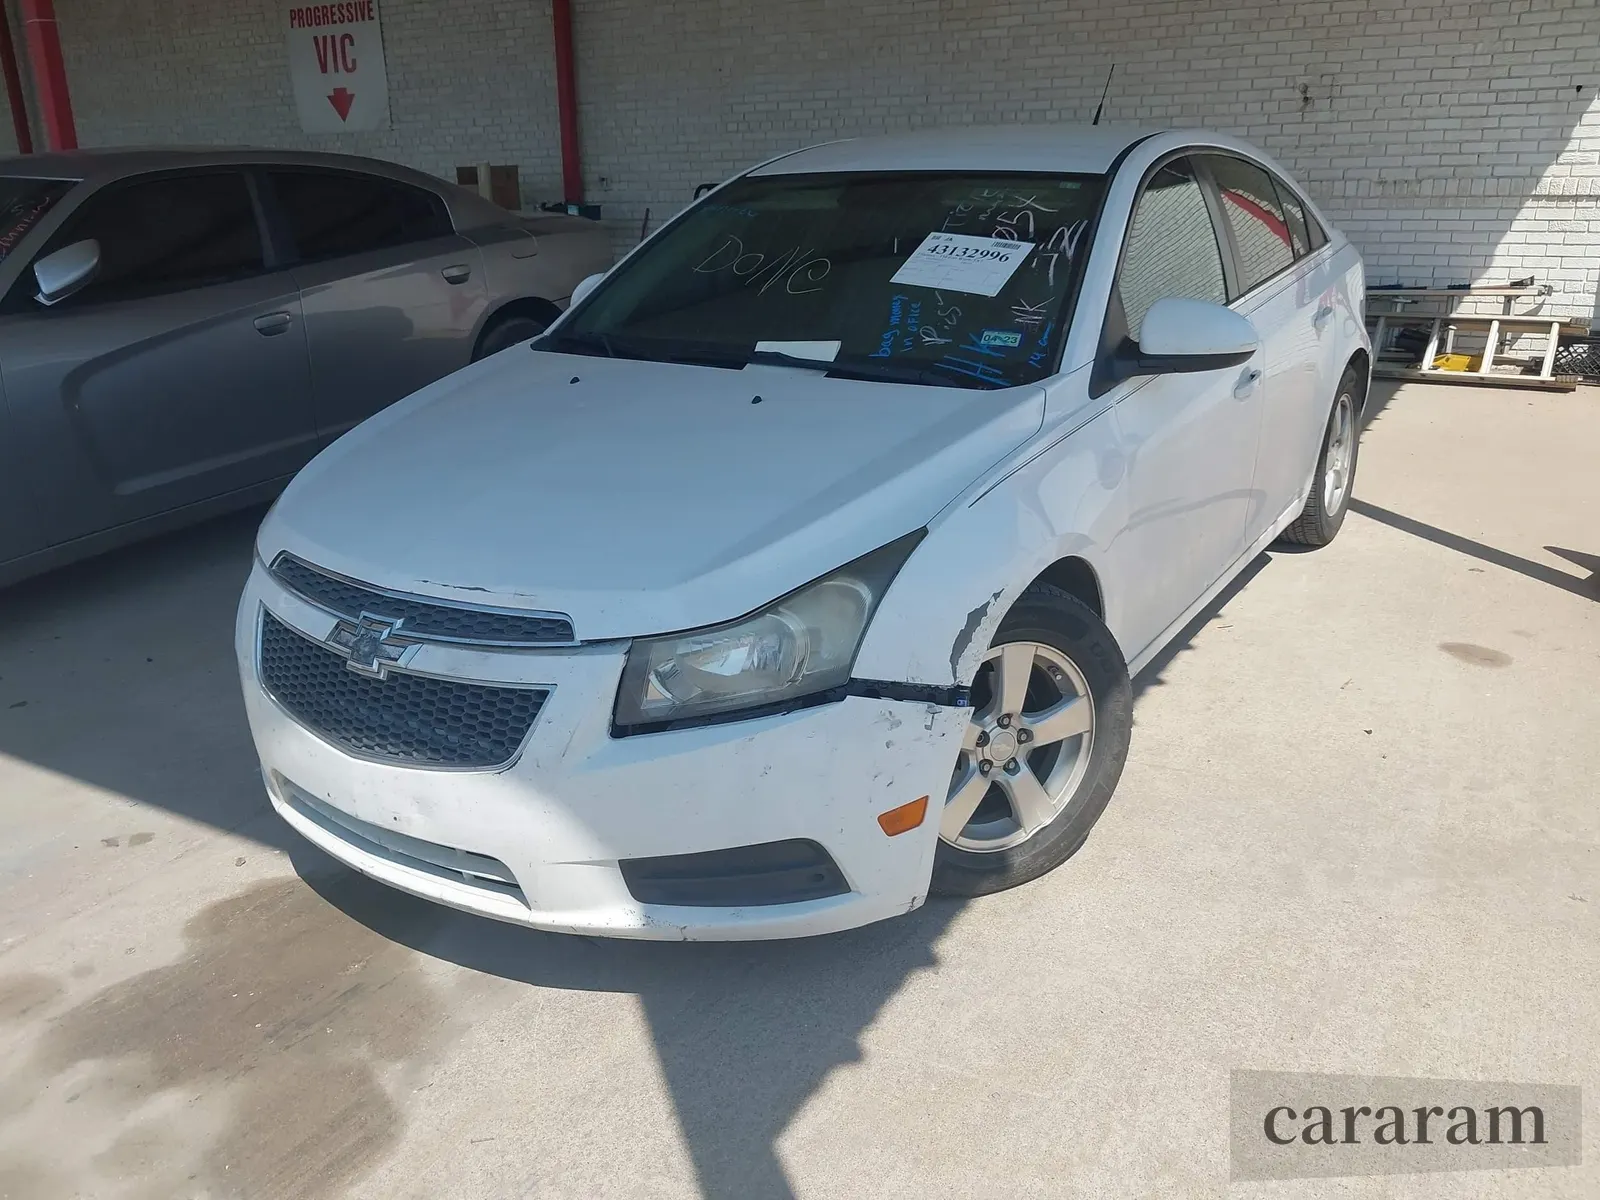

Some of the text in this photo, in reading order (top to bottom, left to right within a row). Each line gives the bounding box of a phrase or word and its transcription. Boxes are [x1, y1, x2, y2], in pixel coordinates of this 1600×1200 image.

[290, 1, 374, 28] PROGRESSIVE
[313, 33, 357, 74] VIC
[927, 243, 1013, 263] 43132996
